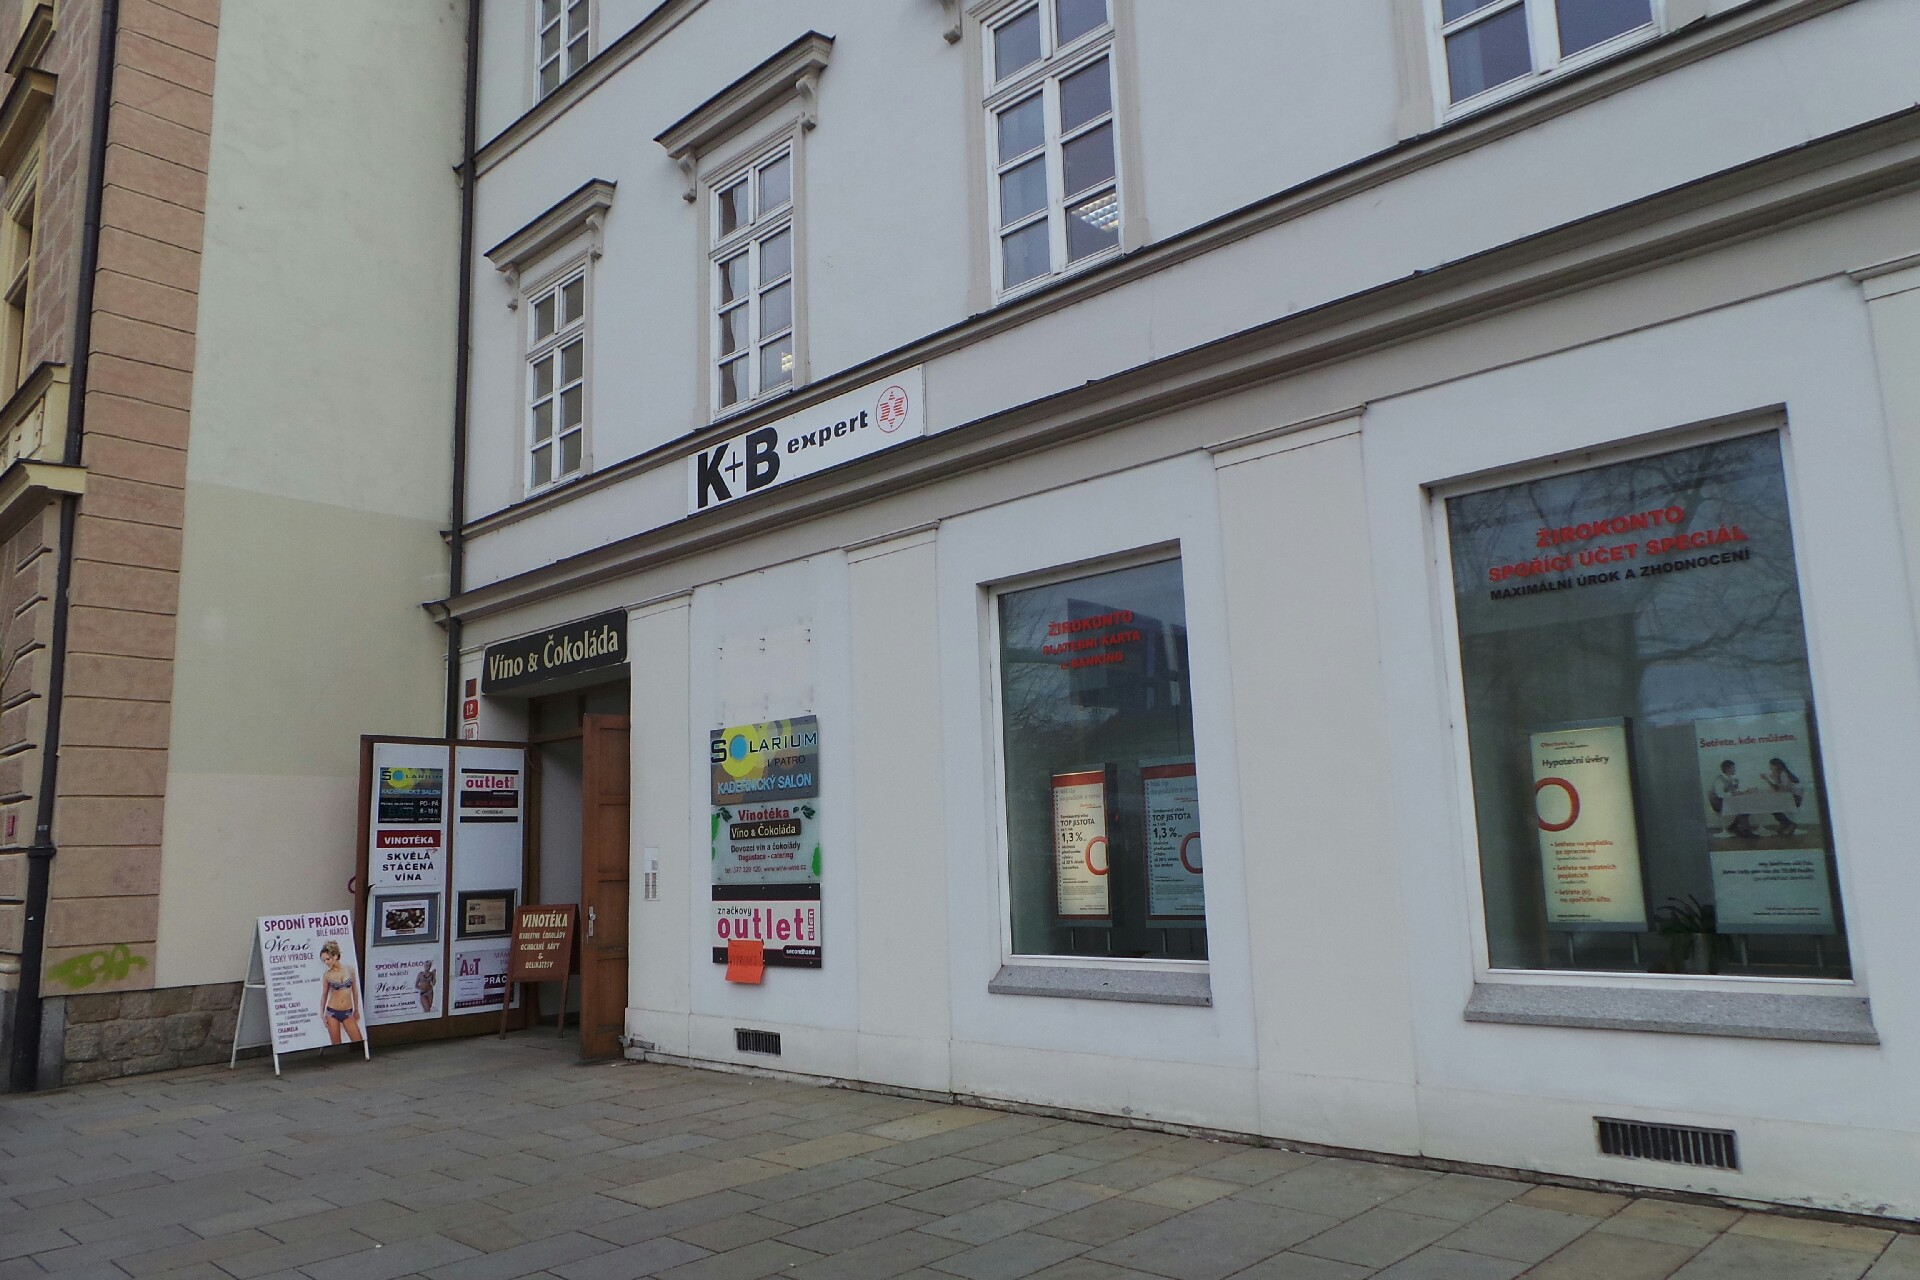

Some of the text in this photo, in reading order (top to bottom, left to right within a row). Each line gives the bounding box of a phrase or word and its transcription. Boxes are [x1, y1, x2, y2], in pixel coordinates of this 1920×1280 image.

[697, 410, 868, 509] K+B expert
[1536, 505, 1685, 547] ŽIROKONTO
[1488, 523, 1748, 582] SPOŘÍCÍ ÚČET SPECIÁL
[1490, 547, 1750, 601] MAXIMÁLNÍ ÚROK A ZHODNOCENÍ
[1048, 609, 1134, 636] ŽIROKONTO
[1101, 630, 1141, 646] KARTA
[489, 624, 619, 681] Víno & Čokoláda
[466, 703, 474, 715] 12
[1738, 735, 1757, 744] kde
[710, 731, 818, 764] SOLARIUM
[774, 754, 806, 766] PATRO
[1542, 755, 1609, 768] Hypoteční úvěry
[465, 775, 510, 788] outlet
[778, 772, 812, 788] SALON
[738, 807, 790, 821] Vinotéka
[1166, 813, 1192, 822] JISTOTA
[1073, 818, 1095, 827] JISTOTA
[731, 823, 796, 838] Víno & Čokoláda
[1061, 831, 1083, 843] 1,3 %
[1153, 826, 1178, 839] 1,3 %
[384, 835, 434, 844] VINOTÉKA
[772, 841, 801, 851] čokolády
[738, 853, 767, 863] Degustace
[770, 852, 794, 860] catering
[382, 861, 434, 871] STÁČENÁ
[395, 873, 422, 881] VÍNA
[718, 906, 752, 917] značkový
[264, 912, 349, 932] SPODNÍ PRÁDLO
[522, 910, 568, 928] VINOTÉKA
[717, 908, 804, 941] outlet
[269, 952, 314, 964] ČESKÝ VÝROBCE
[375, 961, 424, 971] SPODNÍ PRÁDLO
[459, 958, 481, 976] A&T
